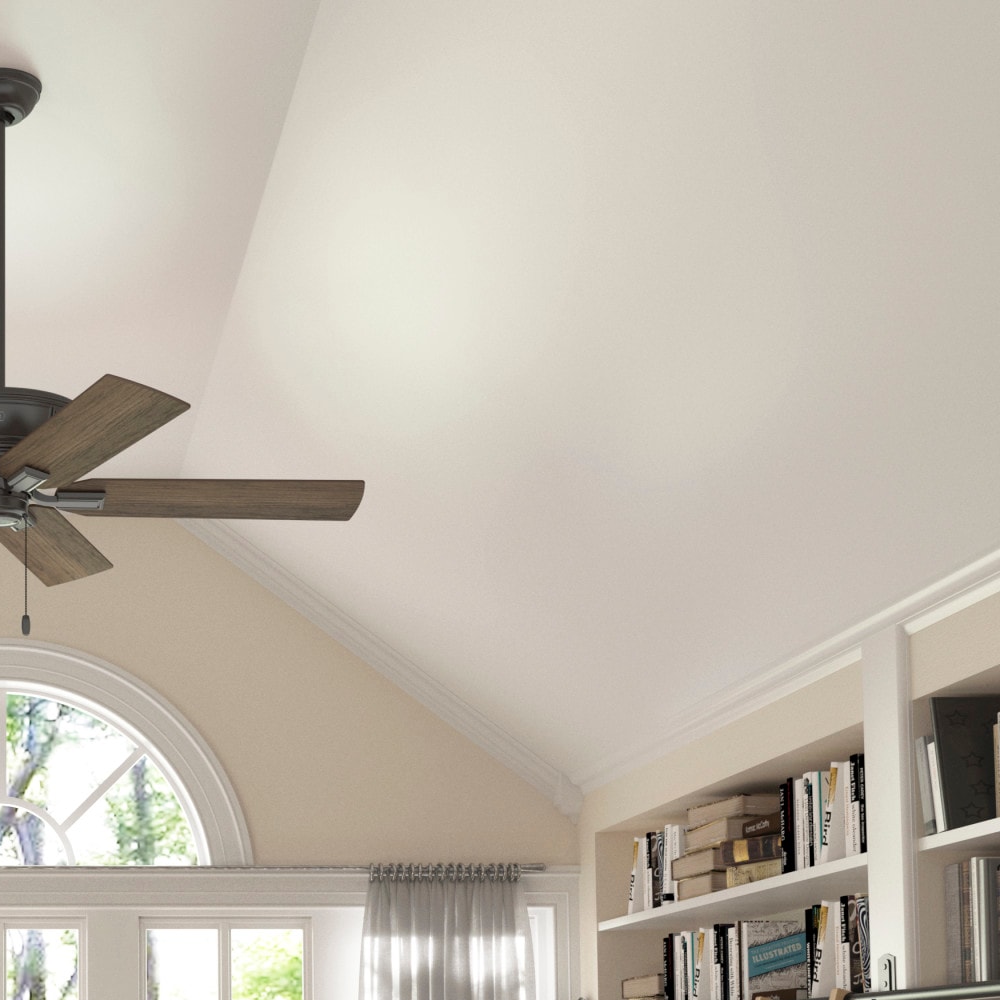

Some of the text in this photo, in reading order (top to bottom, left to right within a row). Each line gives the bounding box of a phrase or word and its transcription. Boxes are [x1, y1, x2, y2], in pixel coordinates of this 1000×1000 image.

[822, 811, 832, 846] Bird
[752, 942, 802, 962] ILLUSTRATED
[813, 948, 822, 982] Bird
